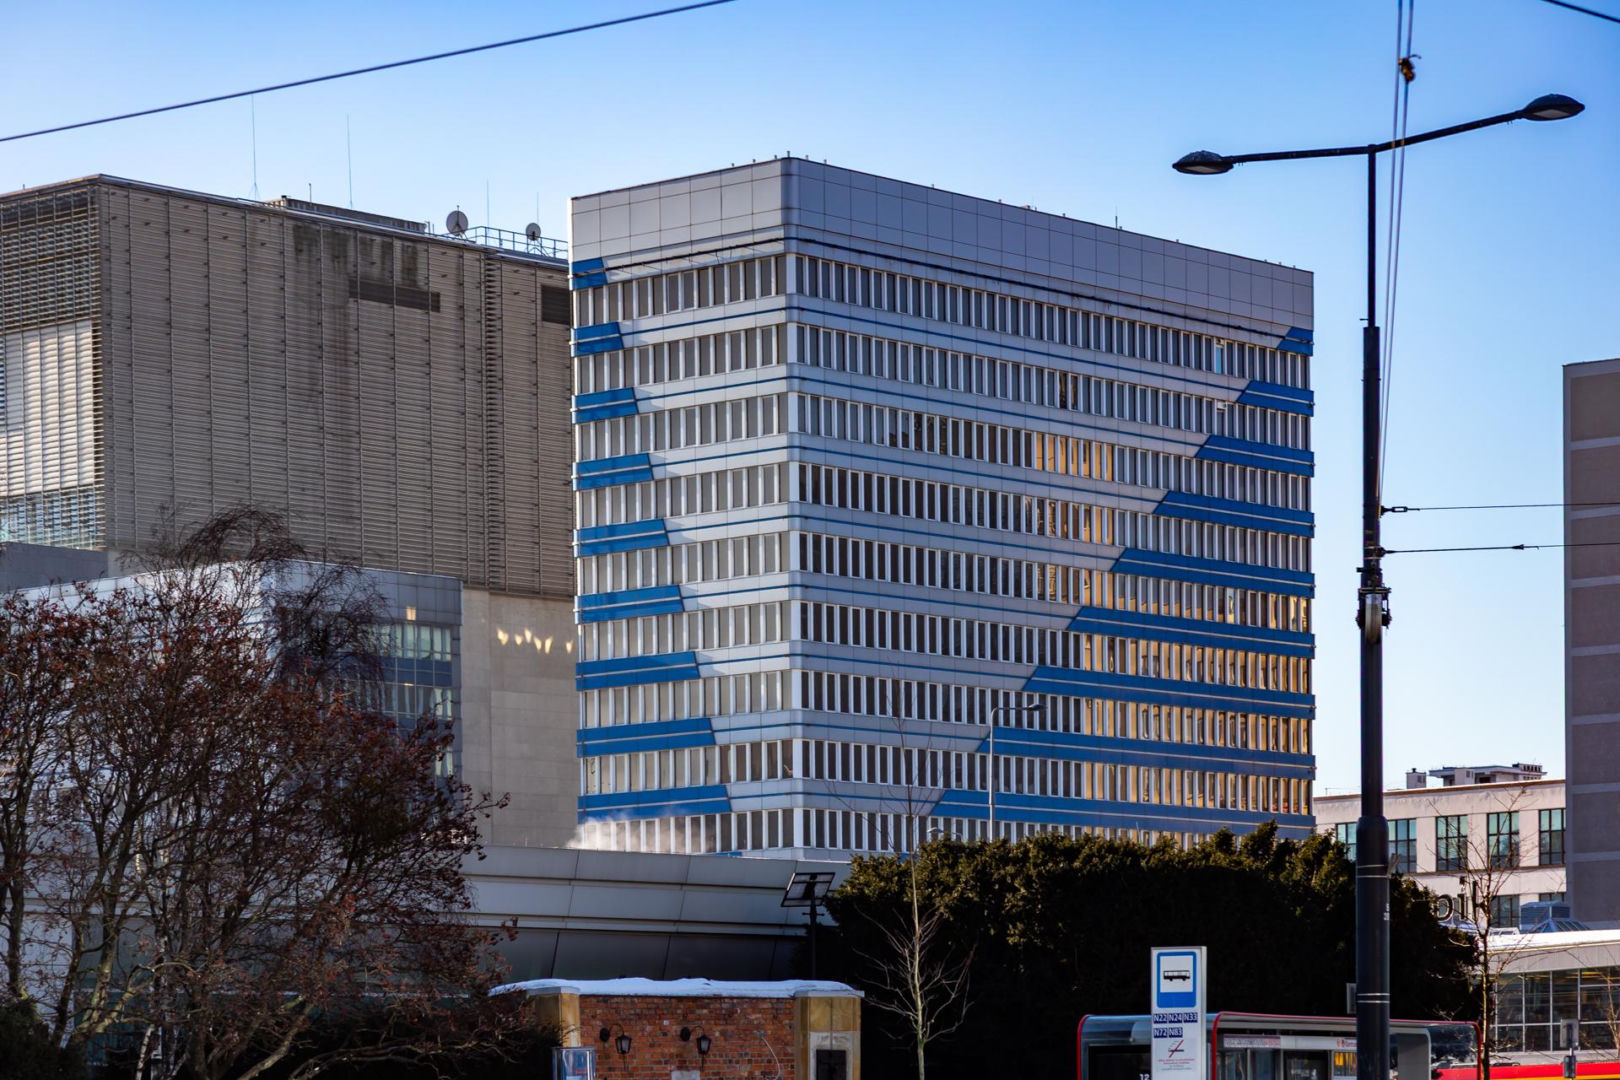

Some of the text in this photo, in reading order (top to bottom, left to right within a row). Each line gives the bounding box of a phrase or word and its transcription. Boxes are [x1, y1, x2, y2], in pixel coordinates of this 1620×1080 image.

[1153, 1013, 1198, 1022] N22 N24 N33
[1153, 1028, 1167, 1036] N72
